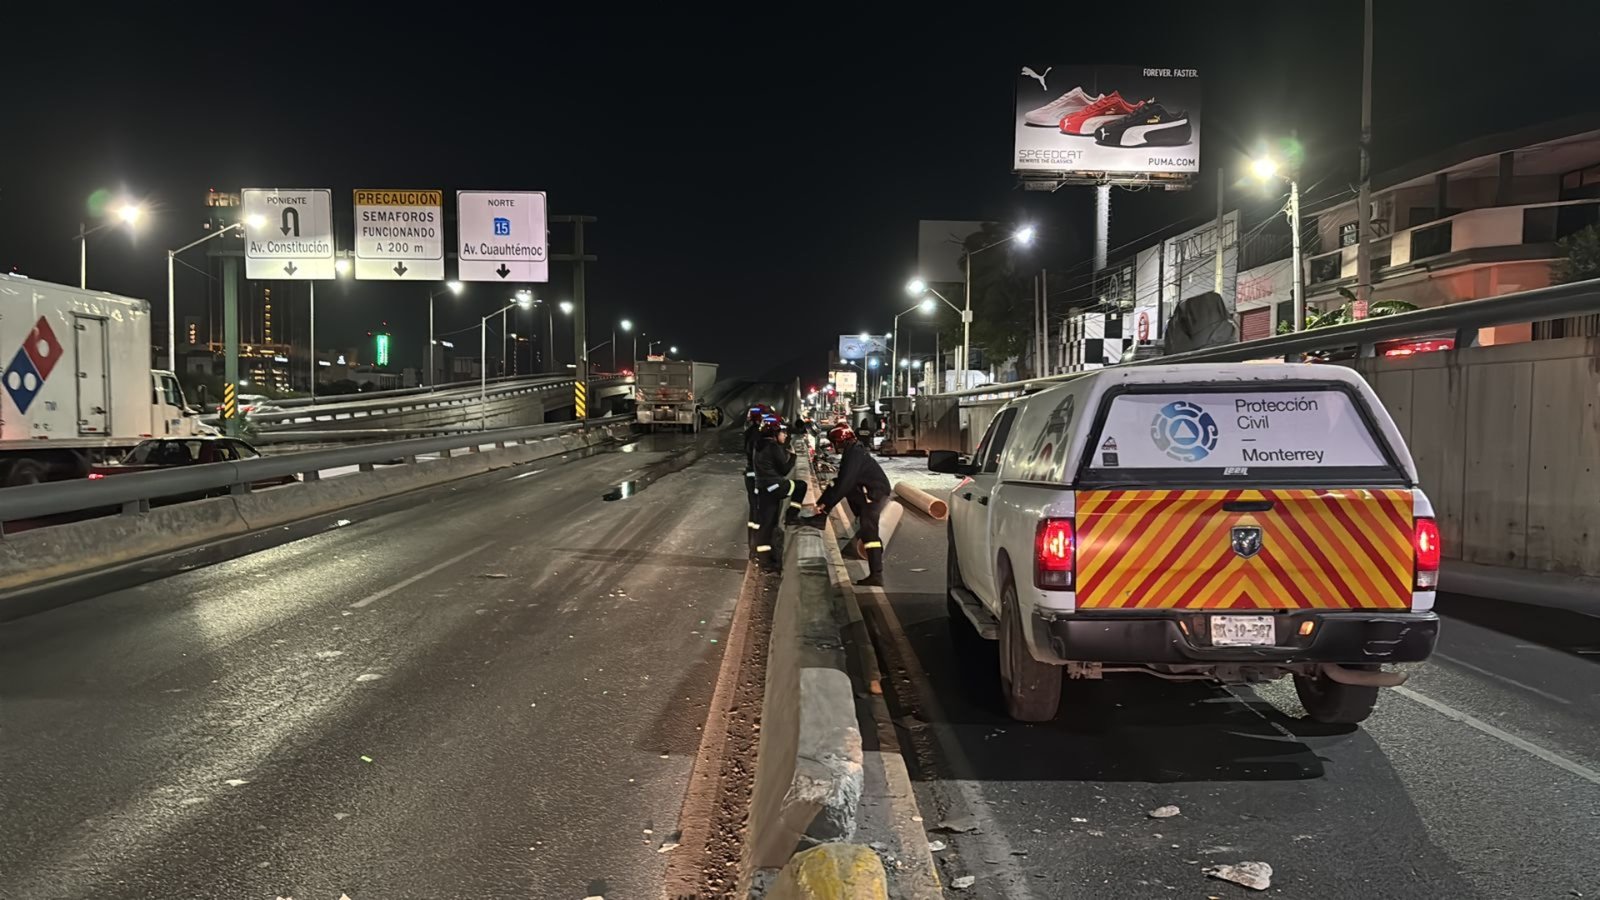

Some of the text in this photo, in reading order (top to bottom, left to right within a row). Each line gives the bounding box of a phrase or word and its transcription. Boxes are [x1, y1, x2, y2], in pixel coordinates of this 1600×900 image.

[1143, 68, 1199, 78] FOREVER. FASTER.
[1018, 149, 1084, 159] SPEEDCAT
[1148, 158, 1196, 166] PUMA.COM
[266, 196, 307, 205] PONIENTE
[357, 191, 438, 205] PRECAUCIÓN
[487, 199, 515, 207] NORTE
[362, 211, 434, 222] SEMAFOROS
[362, 226, 436, 238] FUNCIONANDO
[496, 223, 508, 234] 15
[250, 239, 330, 254] Av. Constitución
[376, 242, 424, 253] A 200 m
[463, 243, 543, 256] Av. Cuauhtémoc
[1235, 396, 1319, 413] Protección
[1236, 415, 1270, 430] Civil
[1241, 447, 1325, 464] Monterrey
